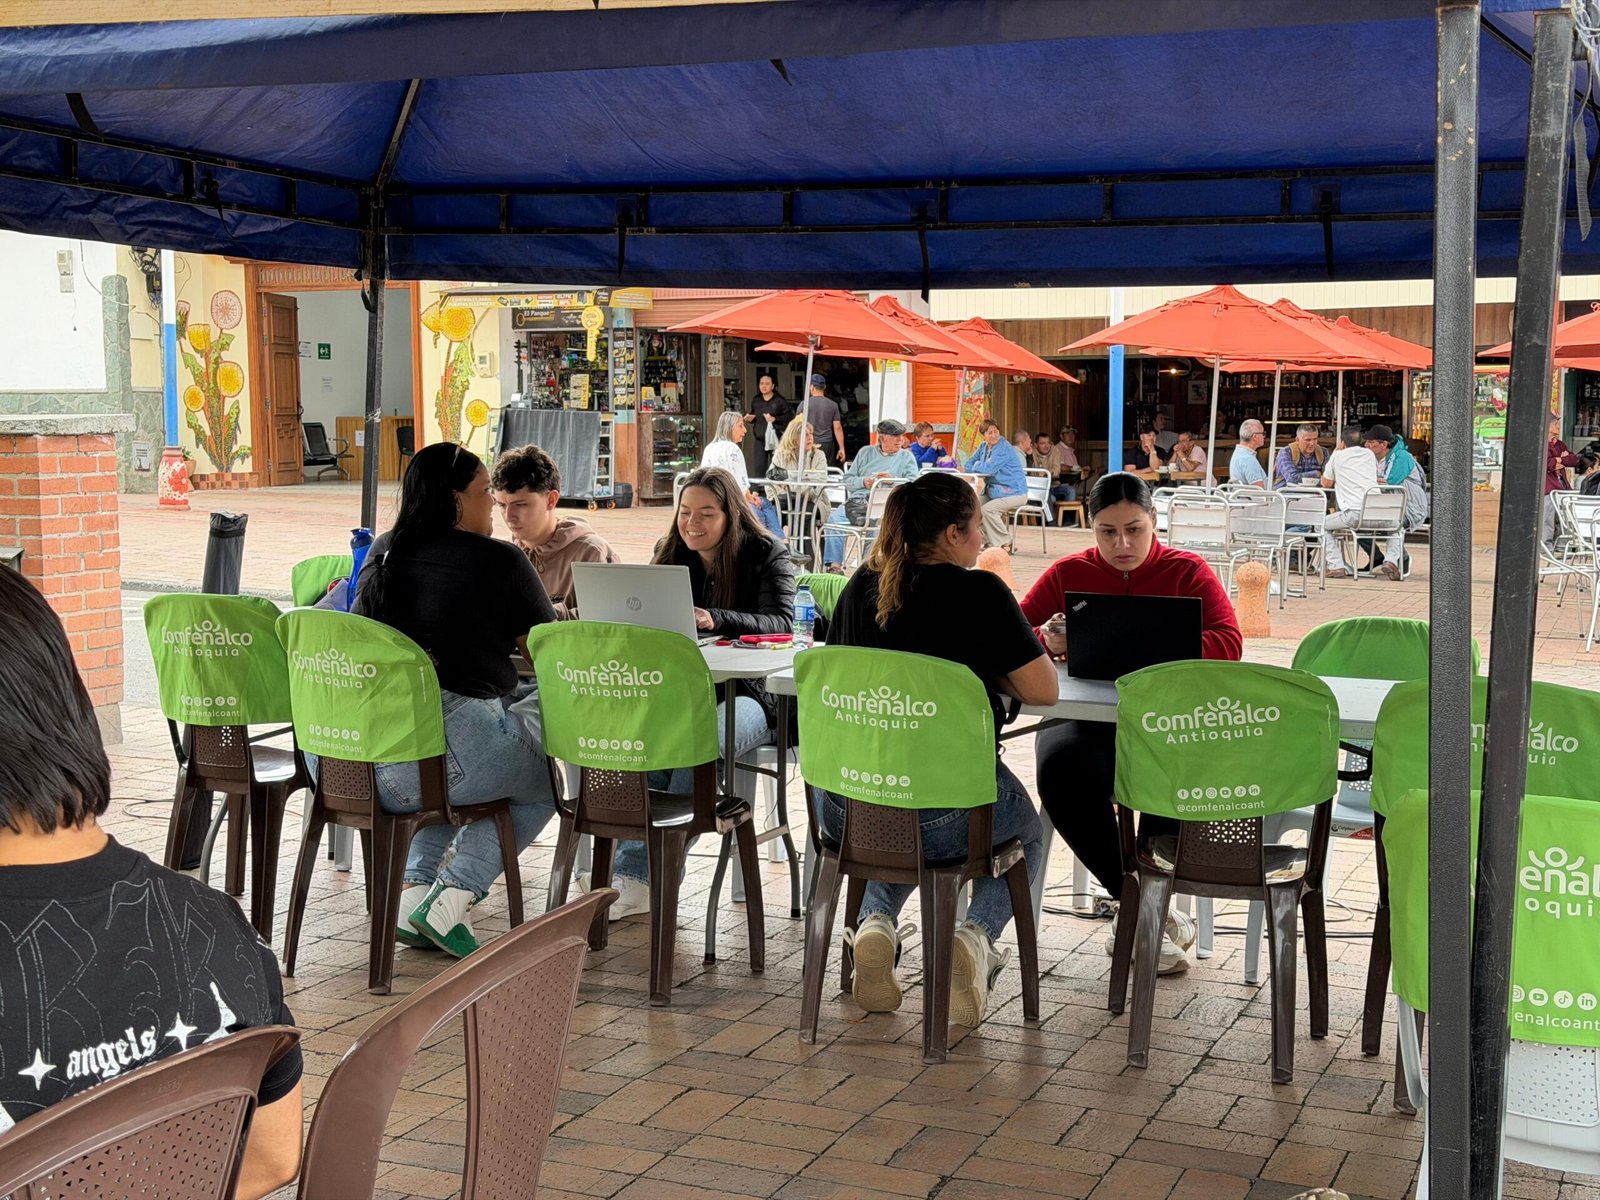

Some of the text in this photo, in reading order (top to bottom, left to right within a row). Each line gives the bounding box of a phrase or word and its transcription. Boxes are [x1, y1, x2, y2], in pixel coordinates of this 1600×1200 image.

[628, 596, 641, 611] hp
[292, 650, 377, 678] Comfenalco
[556, 660, 664, 686] Comfenalco
[304, 671, 363, 689] Antioquia
[570, 684, 648, 700] Antioquia
[821, 684, 937, 717] Comfenalco
[835, 709, 919, 731] Antioquia
[1141, 702, 1281, 733] Comfenalco
[1166, 725, 1264, 745] Antioquia
[578, 750, 648, 763] @comfenalcoant
[839, 781, 913, 800] @comfenalcoant
[1177, 800, 1265, 813] @comfenalcoant
[67, 1025, 156, 1080] angels
